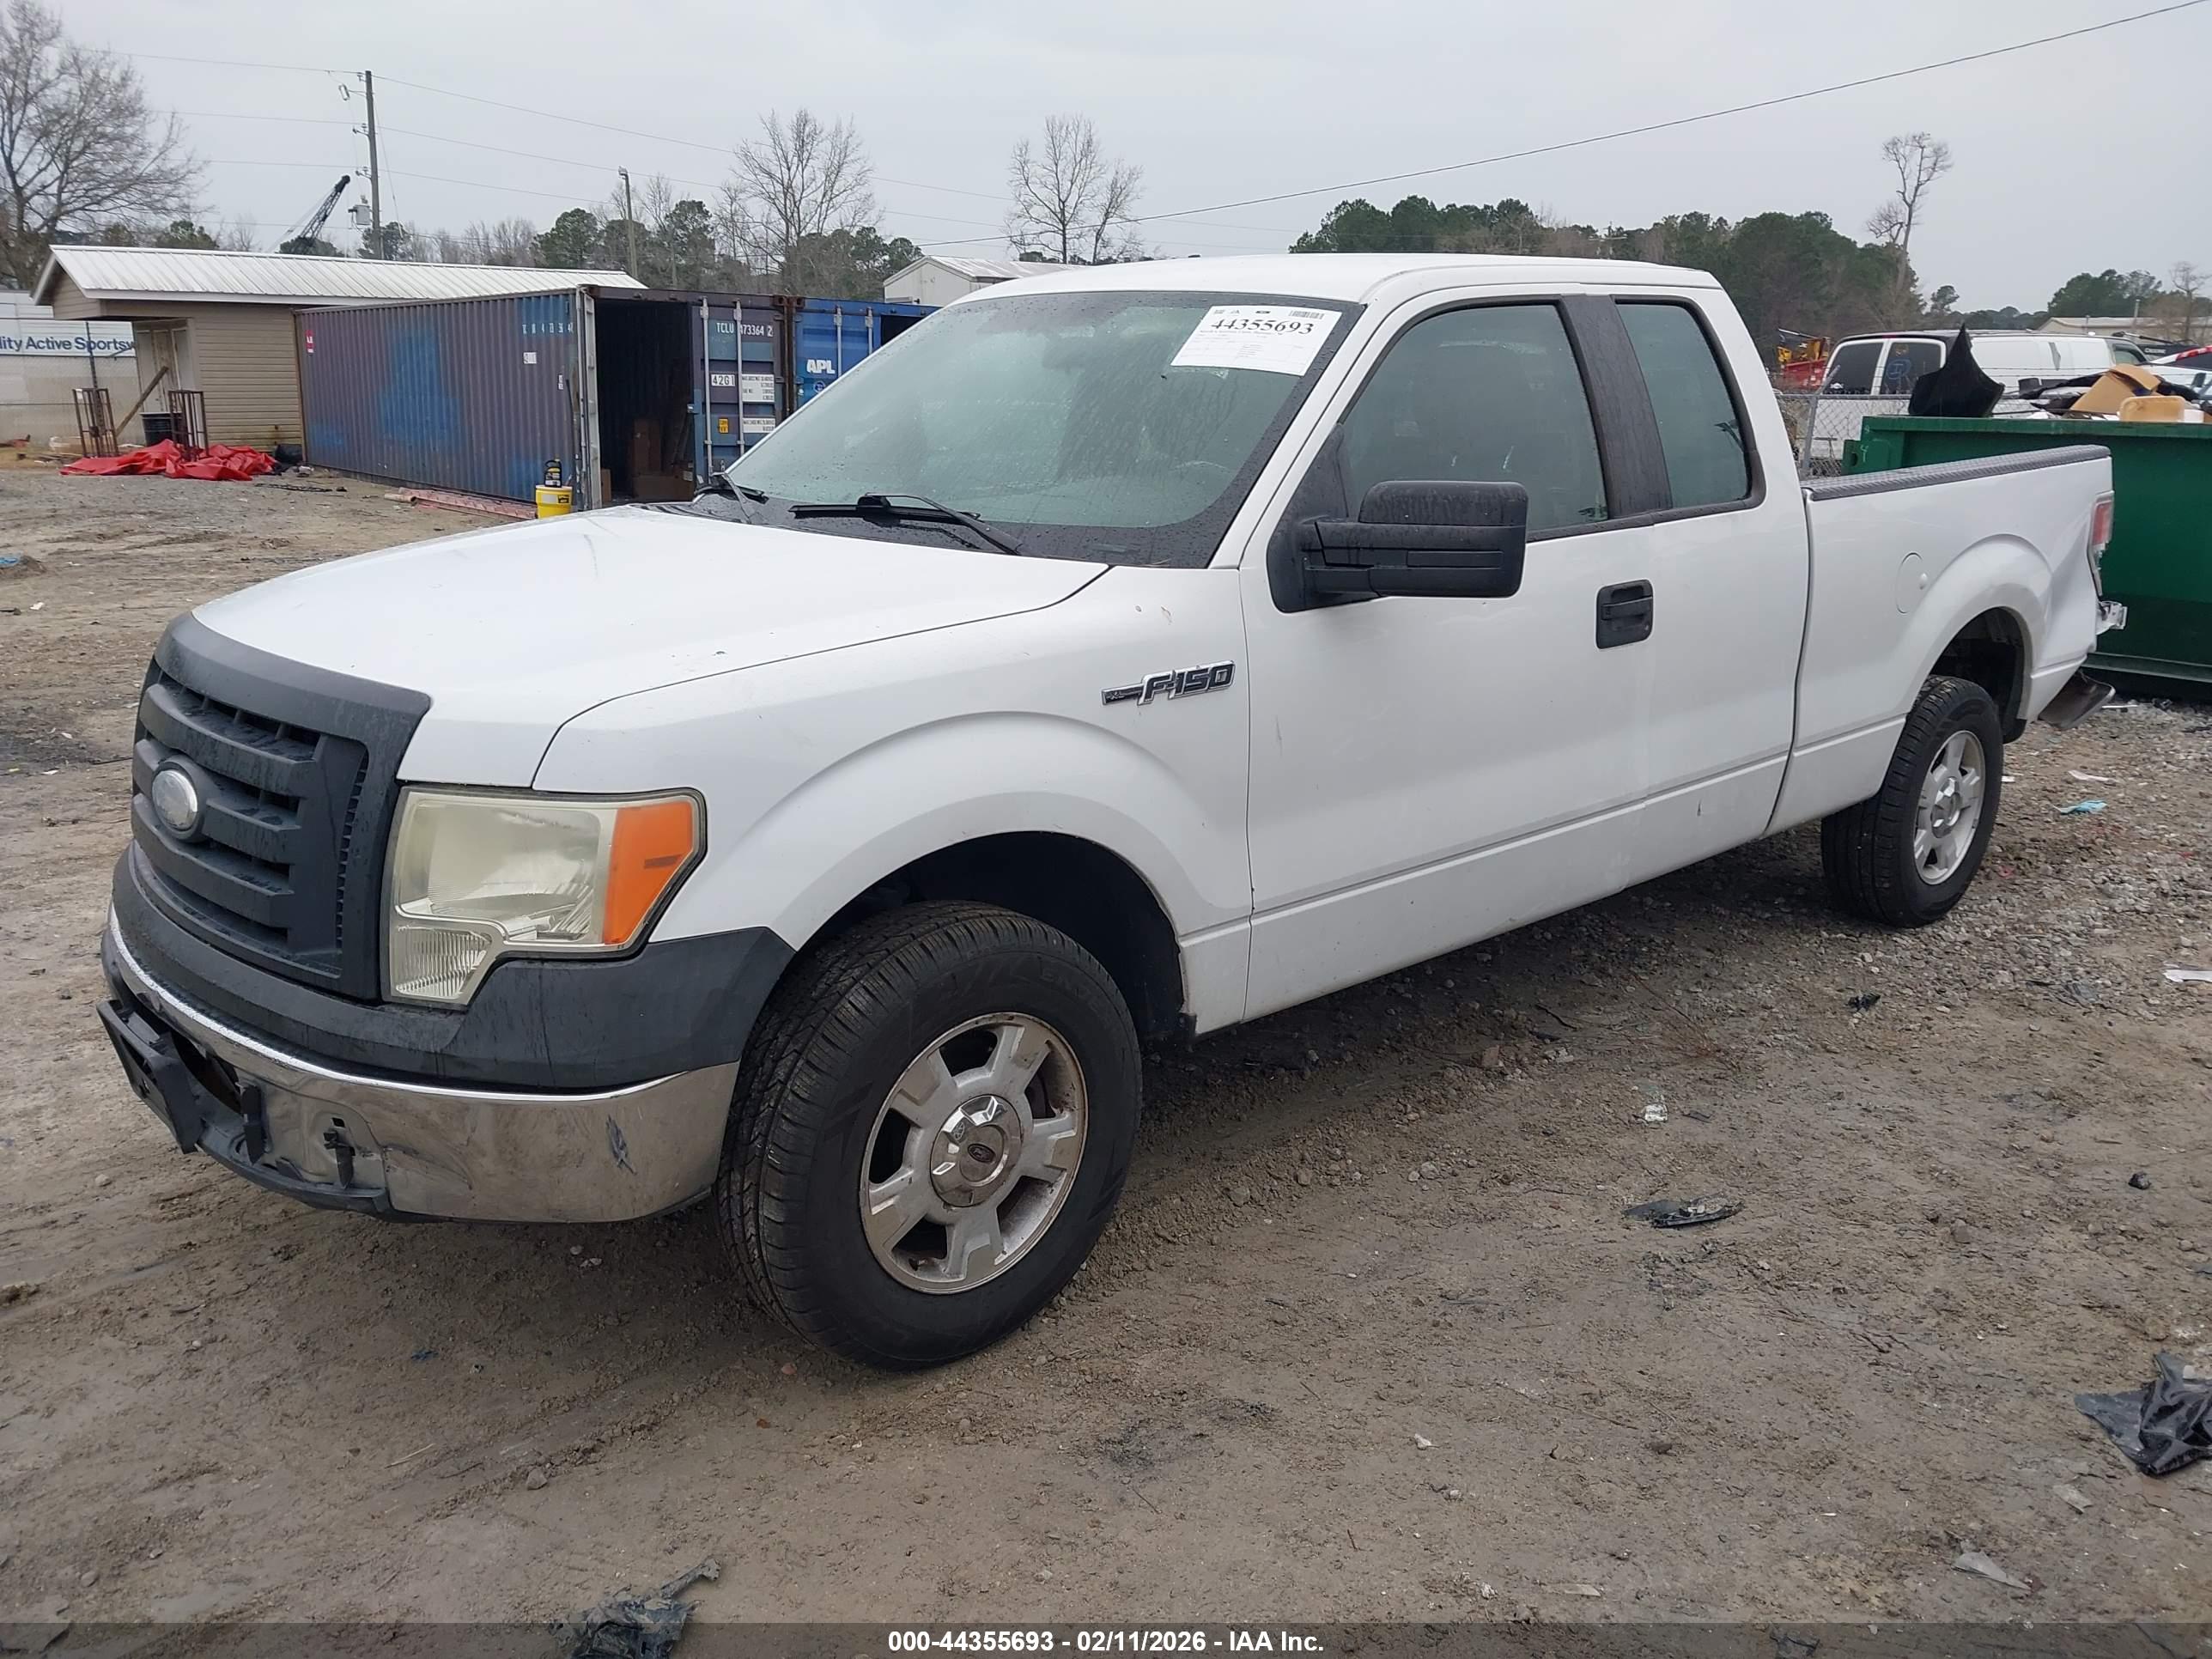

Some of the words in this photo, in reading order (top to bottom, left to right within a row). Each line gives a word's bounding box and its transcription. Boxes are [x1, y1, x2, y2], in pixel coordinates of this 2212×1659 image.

[716, 322, 734, 334] TCLU
[1211, 319, 1314, 335] 44355693
[26, 336, 72, 350] Active
[806, 359, 836, 374] APL
